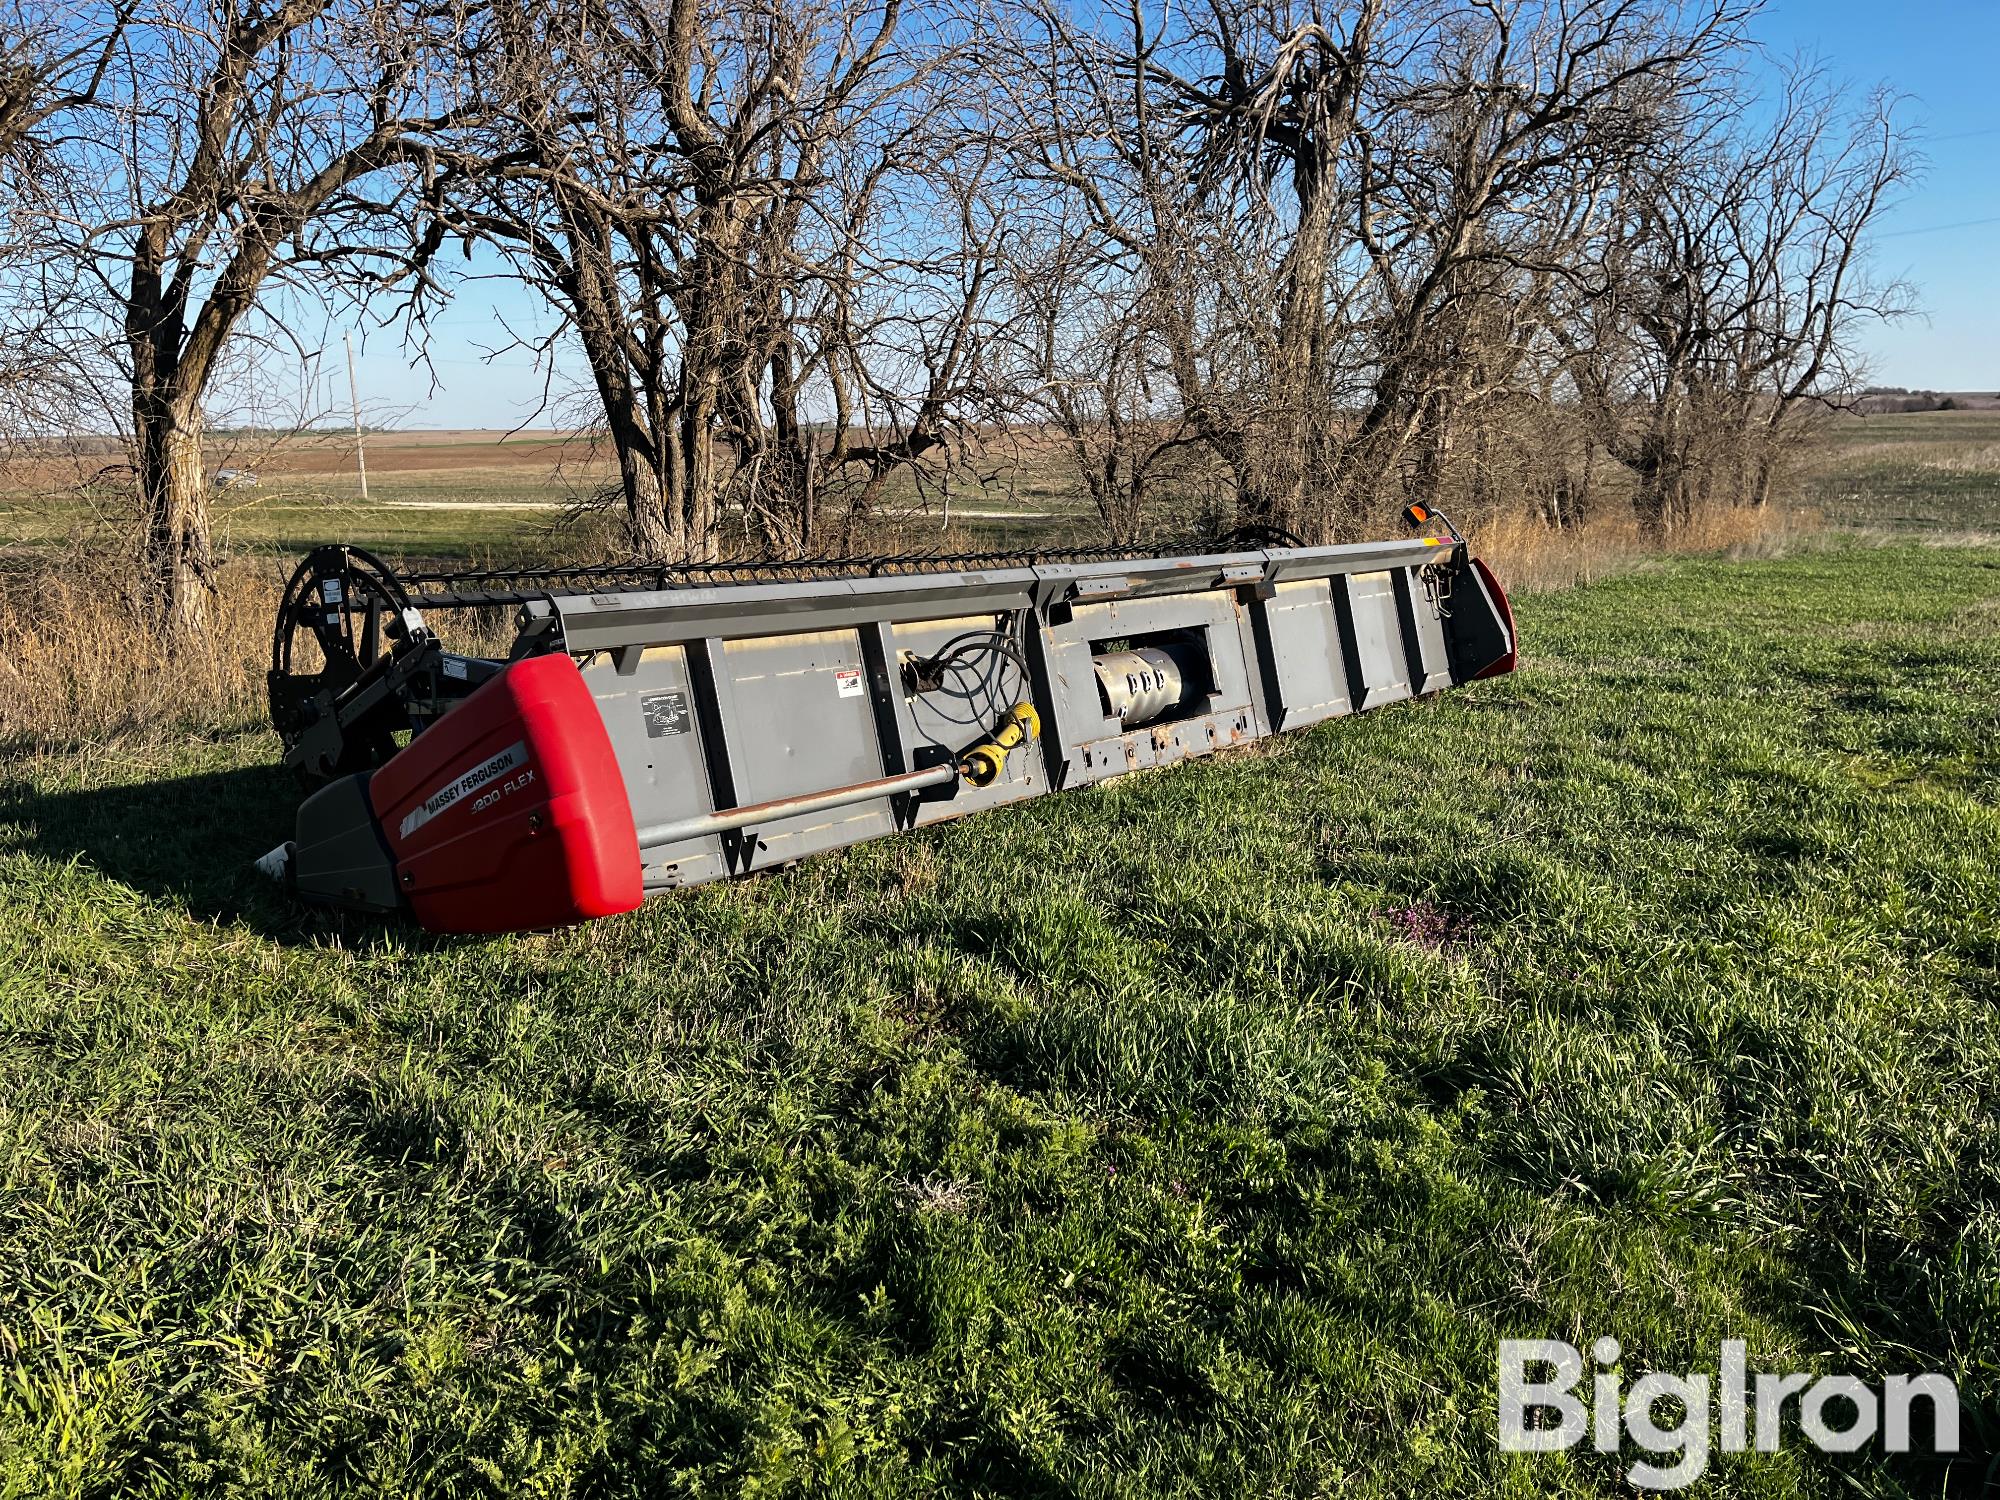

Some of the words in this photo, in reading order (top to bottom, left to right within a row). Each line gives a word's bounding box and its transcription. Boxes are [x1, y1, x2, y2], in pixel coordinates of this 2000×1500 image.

[427, 784, 460, 814] MASSEY
[462, 754, 513, 792] FERGUSON
[504, 770, 536, 795] FLEX
